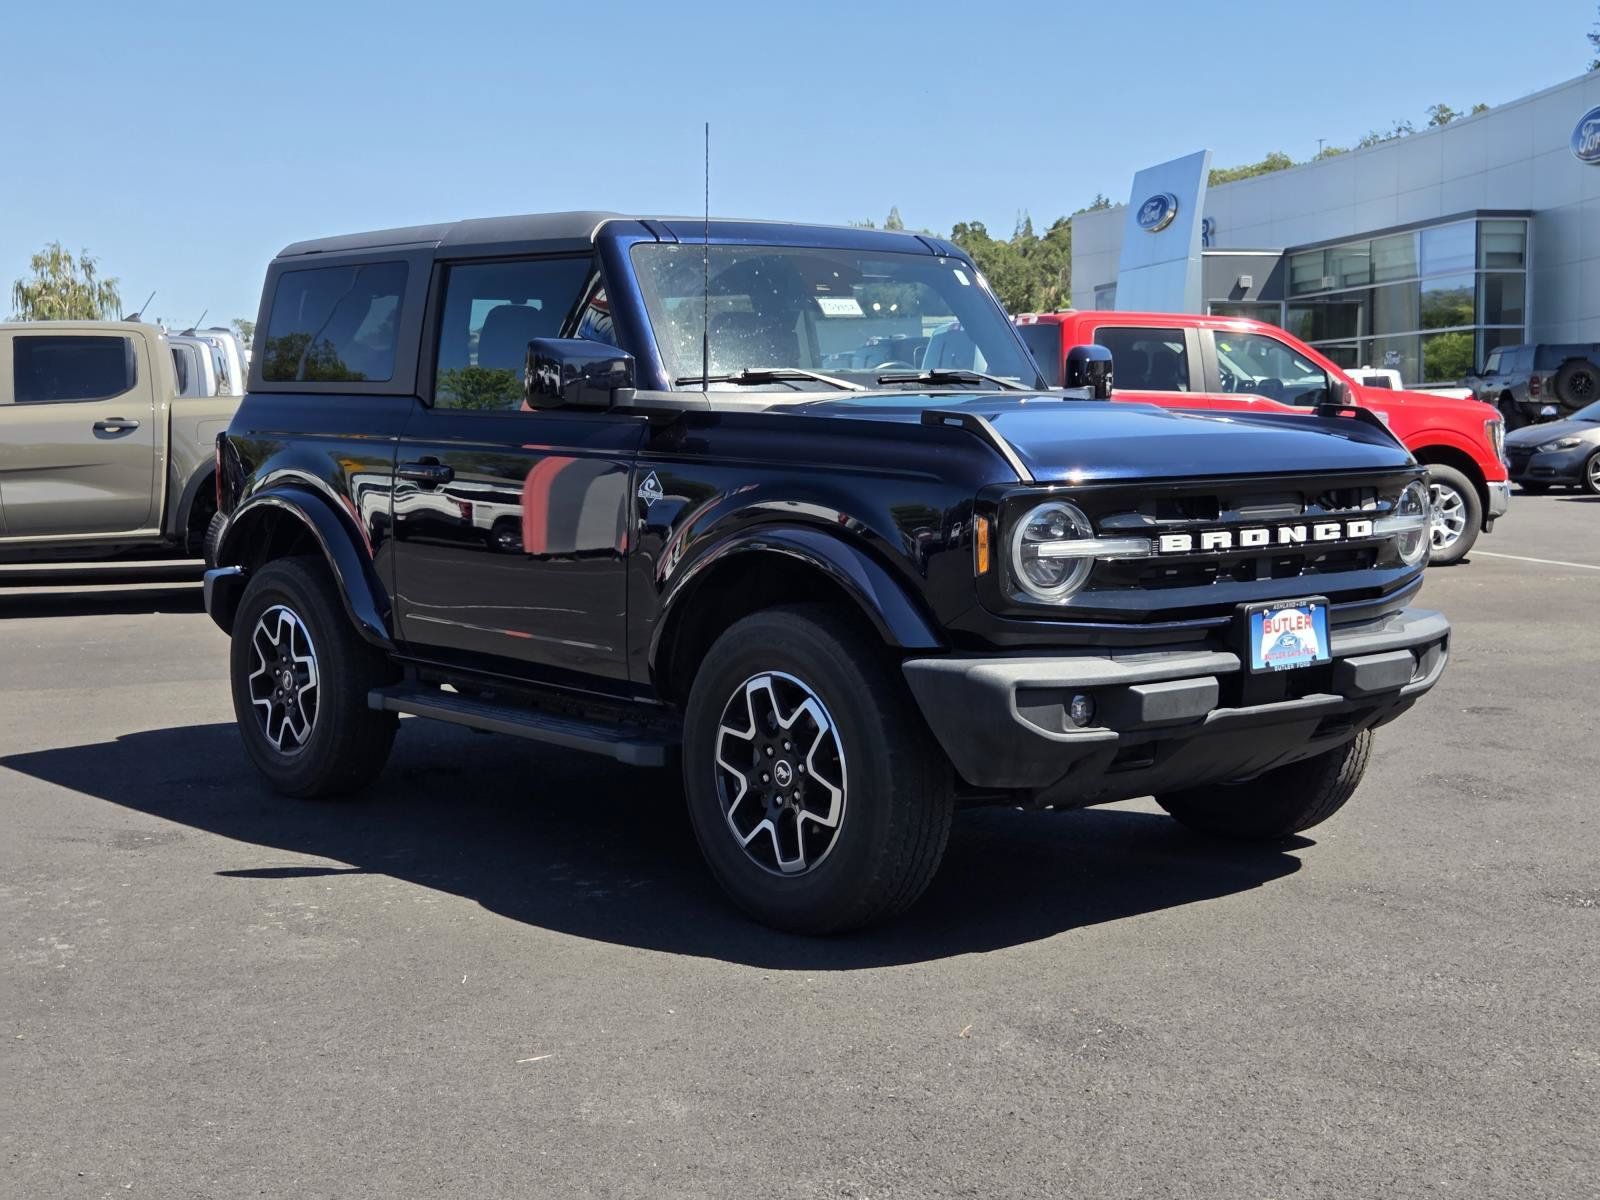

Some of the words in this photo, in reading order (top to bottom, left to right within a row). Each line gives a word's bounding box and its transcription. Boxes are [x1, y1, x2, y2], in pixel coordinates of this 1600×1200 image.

[1579, 118, 1600, 154] For
[1141, 201, 1163, 224] Ford
[1159, 520, 1373, 552] BRONCO
[1263, 614, 1312, 634] BUTLER
